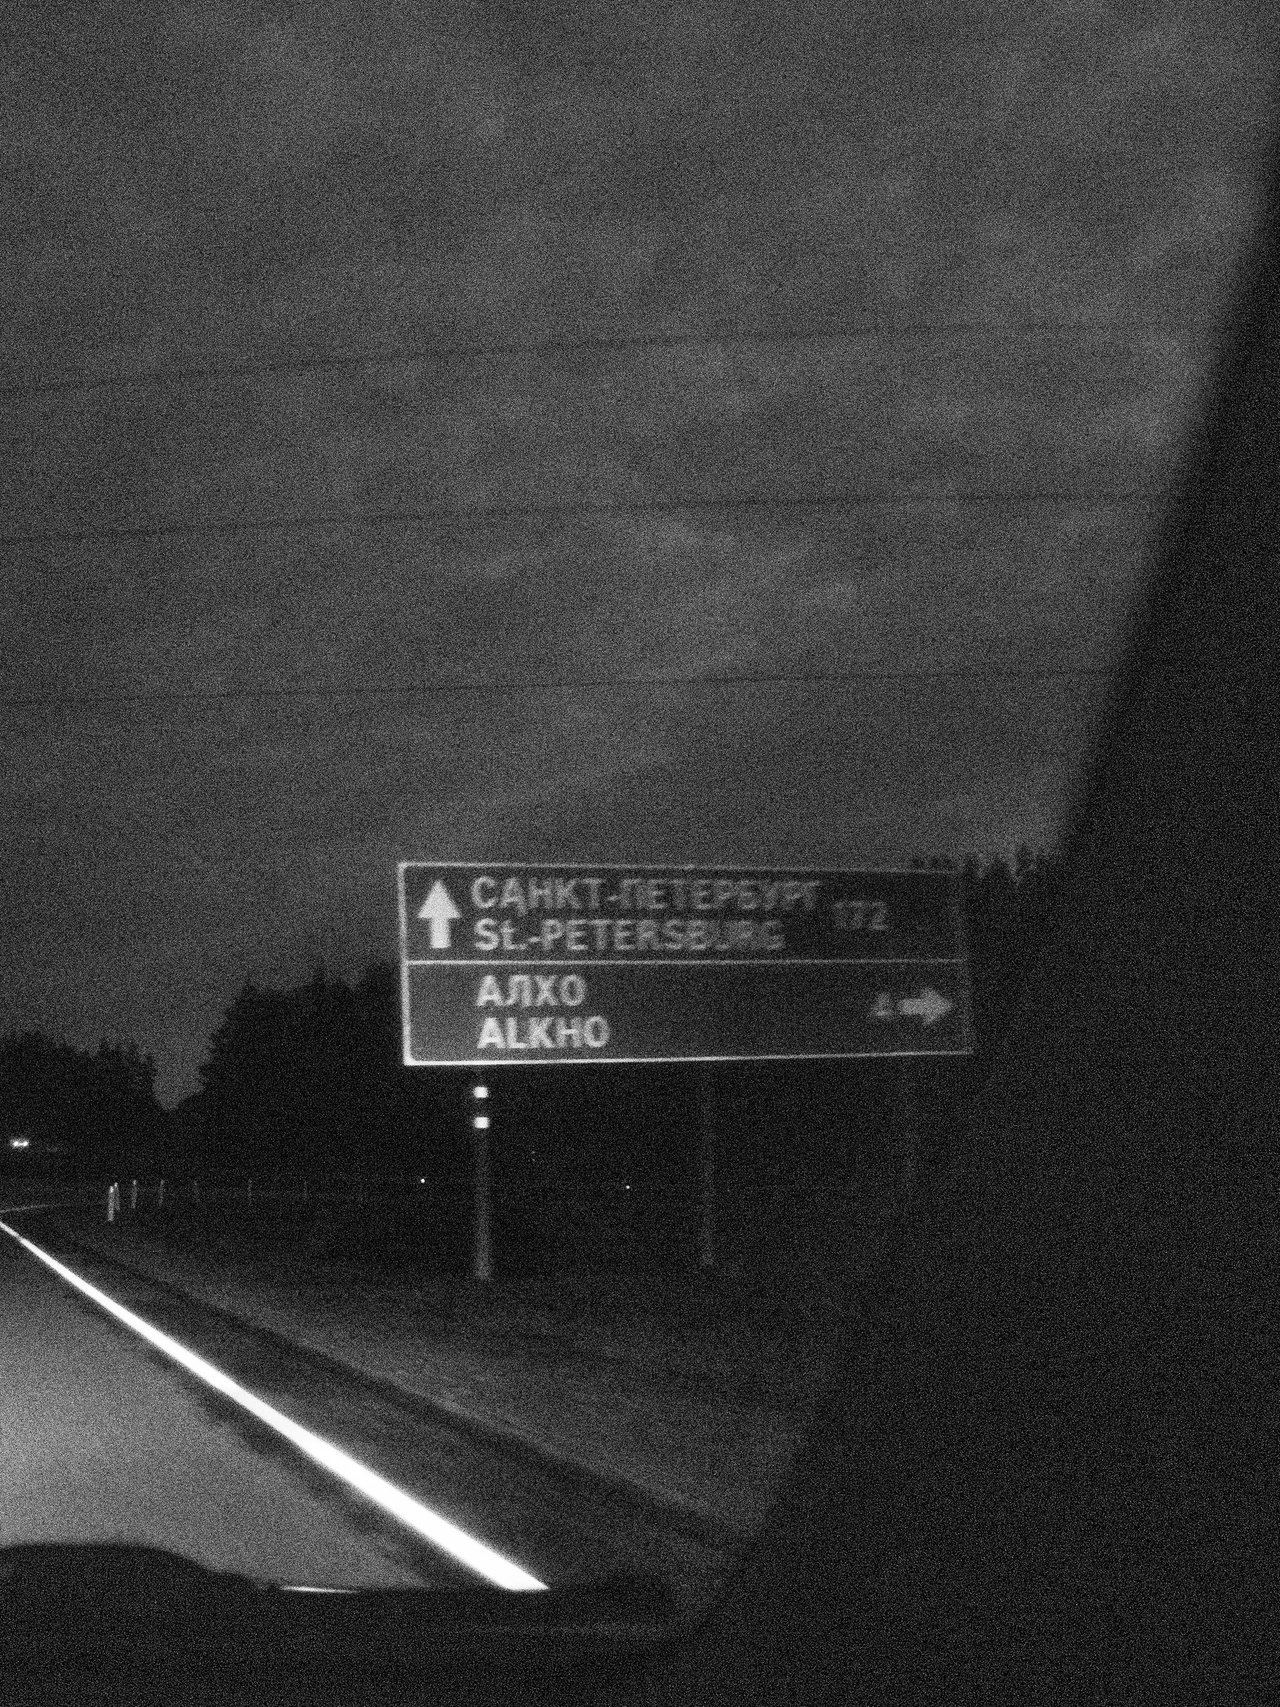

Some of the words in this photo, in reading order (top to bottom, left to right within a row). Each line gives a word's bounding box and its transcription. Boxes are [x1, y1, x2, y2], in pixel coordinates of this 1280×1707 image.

[470, 875, 821, 913] САНКТ-ПЕТЕРБУРГ
[476, 974, 586, 1008] АЛХО
[476, 1014, 611, 1050] ALKHO
